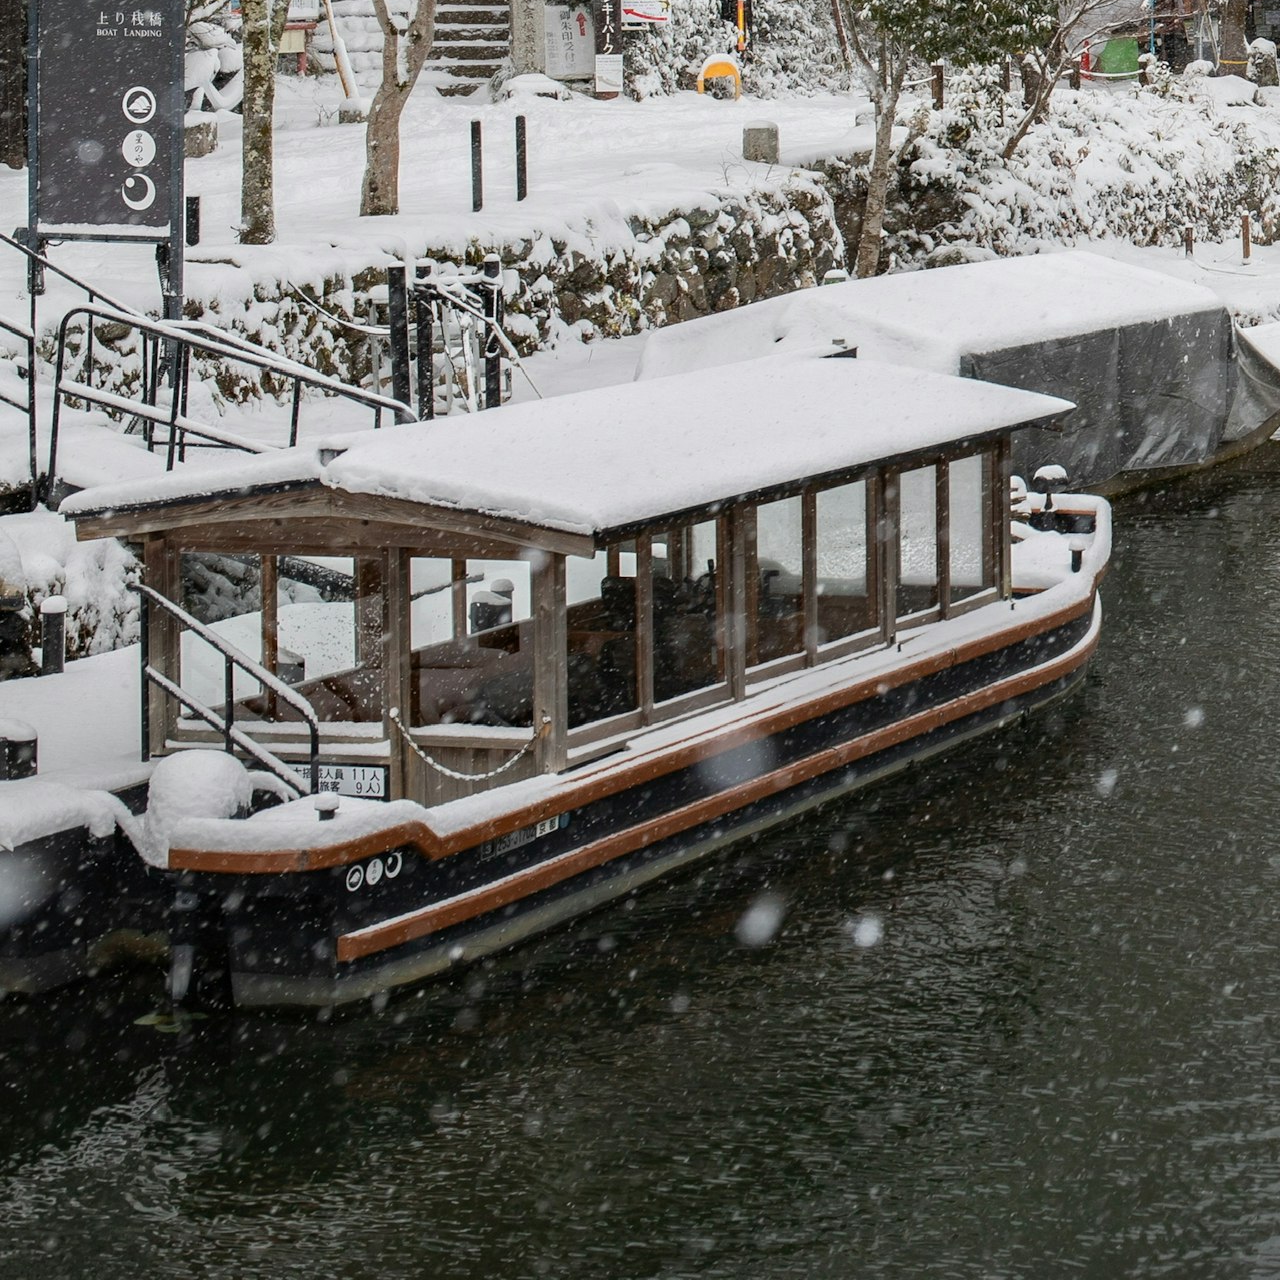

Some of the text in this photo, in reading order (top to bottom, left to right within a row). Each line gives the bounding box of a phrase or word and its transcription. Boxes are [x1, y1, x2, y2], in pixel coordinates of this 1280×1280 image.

[96, 10, 162, 27] 上り桟橋
[96, 27, 162, 37] BOAT LANDING
